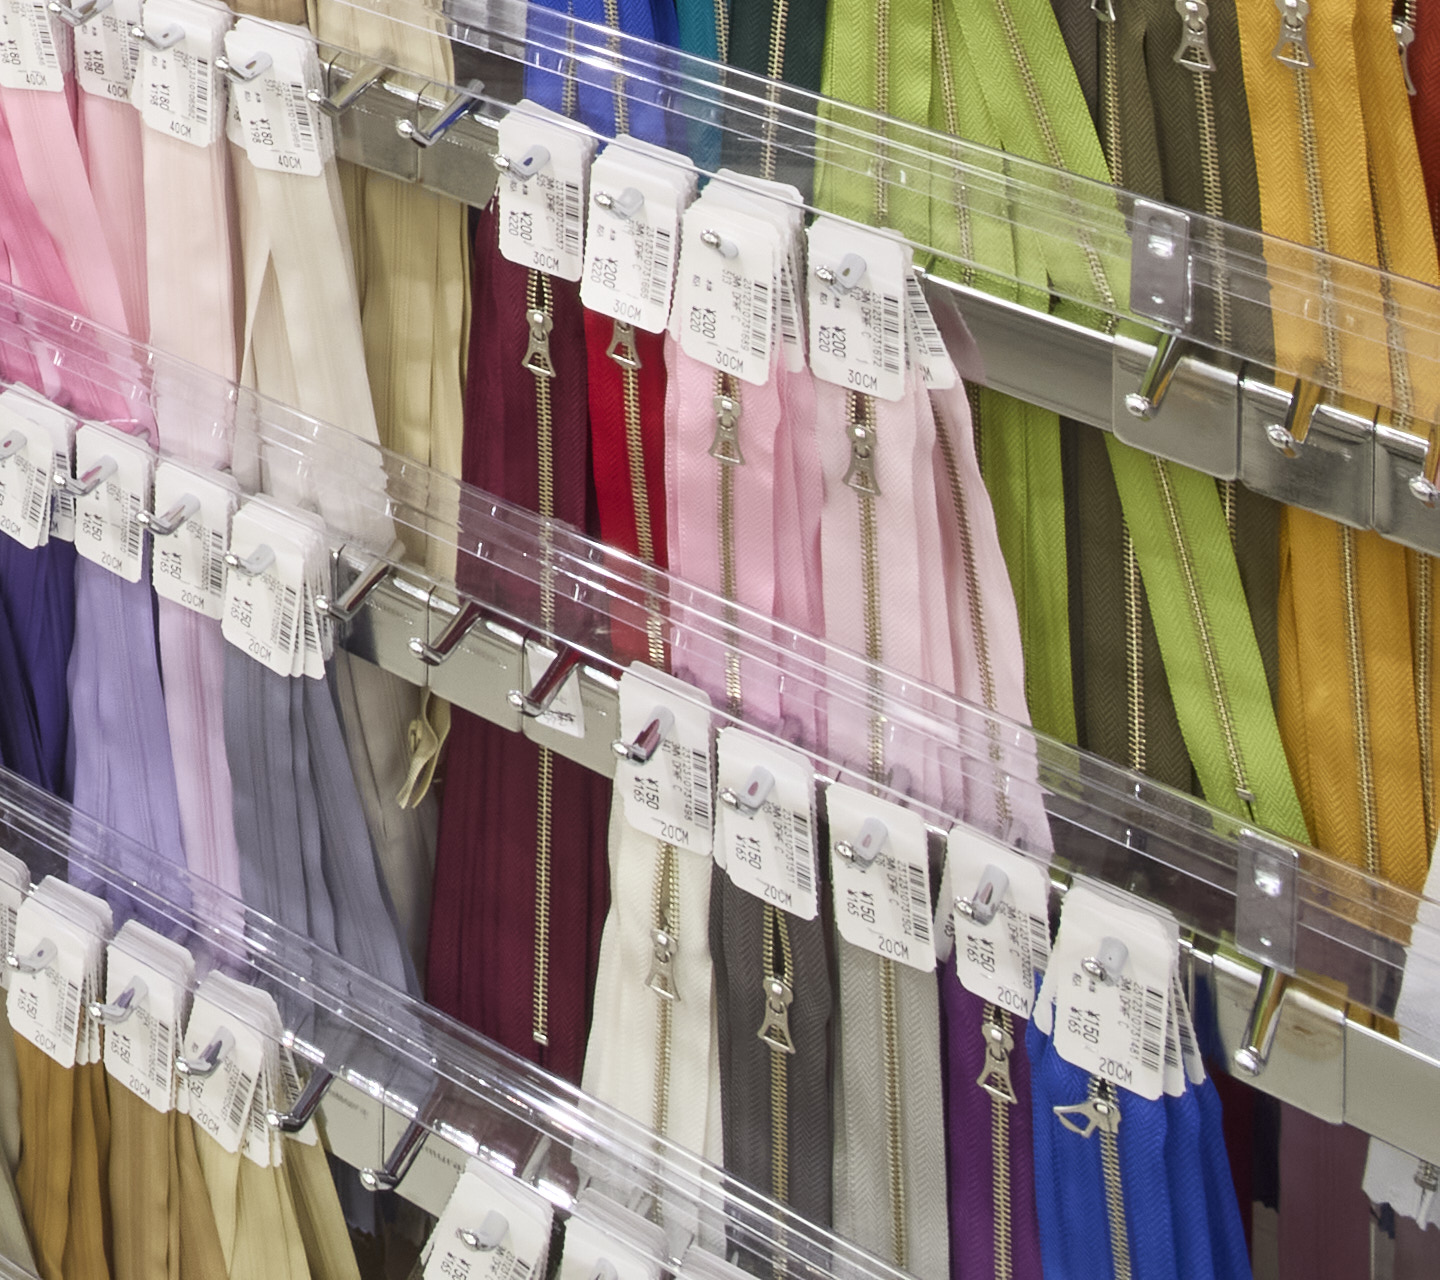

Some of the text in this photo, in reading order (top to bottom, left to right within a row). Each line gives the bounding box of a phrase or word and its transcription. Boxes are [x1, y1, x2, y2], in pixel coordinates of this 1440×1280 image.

[520, 211, 533, 242] ¥200
[532, 250, 559, 272] 30CM
[602, 257, 619, 290] ¥200
[611, 299, 641, 321] 30CM
[702, 307, 717, 340] ¥200
[830, 326, 847, 359] ¥200
[714, 351, 744, 373] 30CM
[847, 369, 879, 390] 30CM
[92, 514, 103, 542] ¥150
[100, 551, 123, 571] 20CM
[170, 551, 182, 581] ¥150
[181, 589, 205, 610] 20CM
[241, 598, 252, 630] ¥150
[248, 638, 272, 662] 20CM
[645, 777, 662, 811] ¥150
[660, 820, 690, 846] 20CM
[748, 837, 763, 871] ¥150
[762, 881, 793, 908] 20CM
[859, 889, 875, 923] ¥150
[877, 935, 910, 960] 20CM
[979, 937, 996, 973] ¥150
[997, 985, 1030, 1012] 20CM
[1081, 1008, 1101, 1045] ¥150
[1098, 1056, 1134, 1082] 20CM
